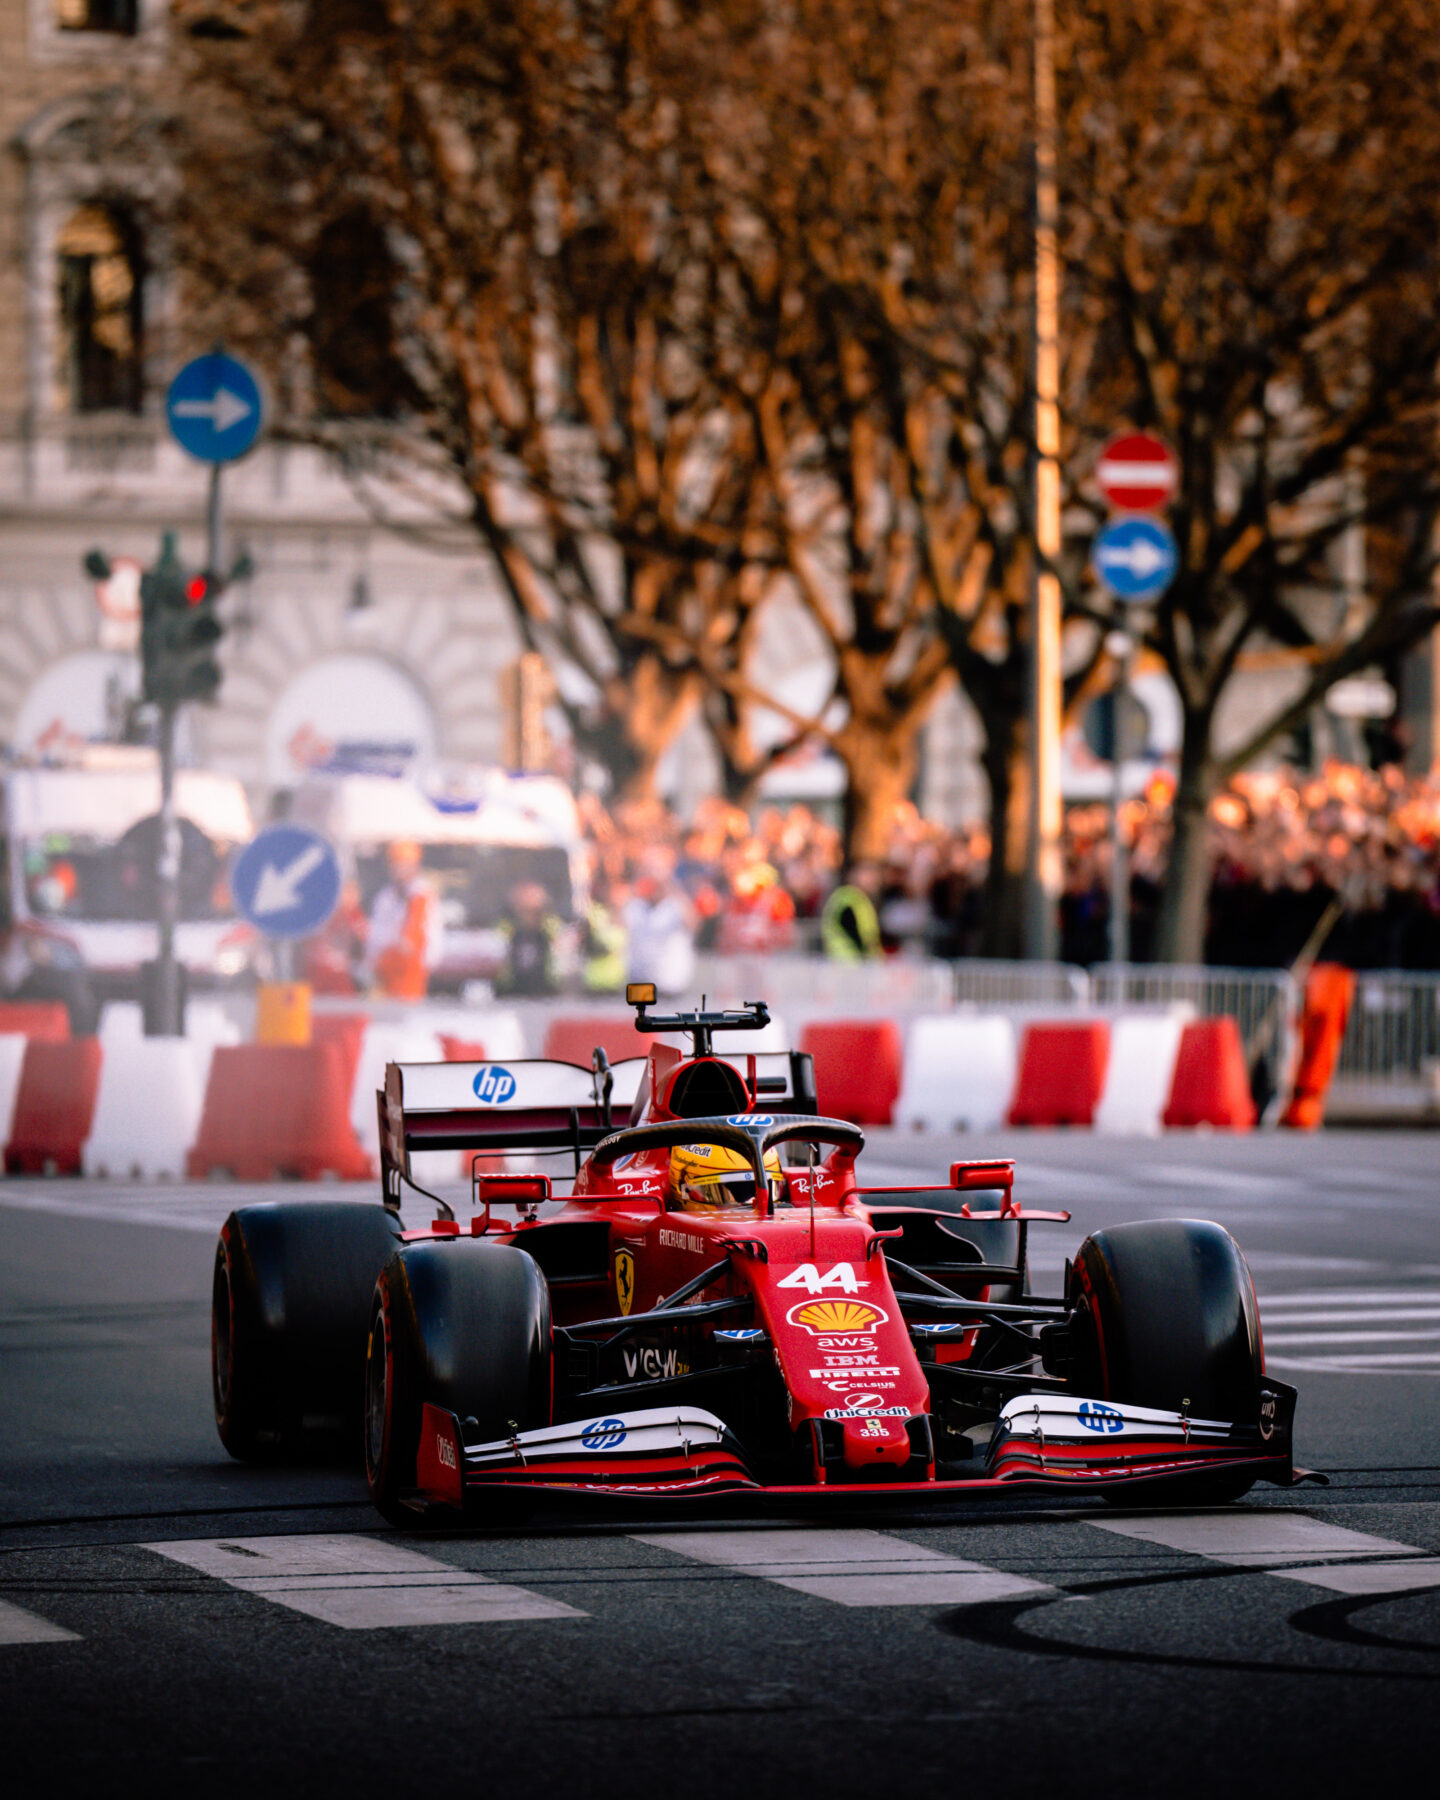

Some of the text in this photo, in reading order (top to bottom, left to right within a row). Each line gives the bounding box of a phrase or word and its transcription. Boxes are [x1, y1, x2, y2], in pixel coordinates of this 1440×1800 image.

[475, 1066, 514, 1104] hp
[792, 1175, 835, 1193] Ray-Ban
[659, 1228, 704, 1254] RICHARD MILLE
[777, 1262, 871, 1294] 44
[817, 1336, 876, 1348] aws
[823, 1355, 880, 1366] IBM
[809, 1367, 900, 1378] PIRELLI
[825, 1407, 911, 1419] UniCredit
[1080, 1402, 1122, 1432] hp
[583, 1419, 625, 1449] hp
[860, 1428, 890, 1437] 335
